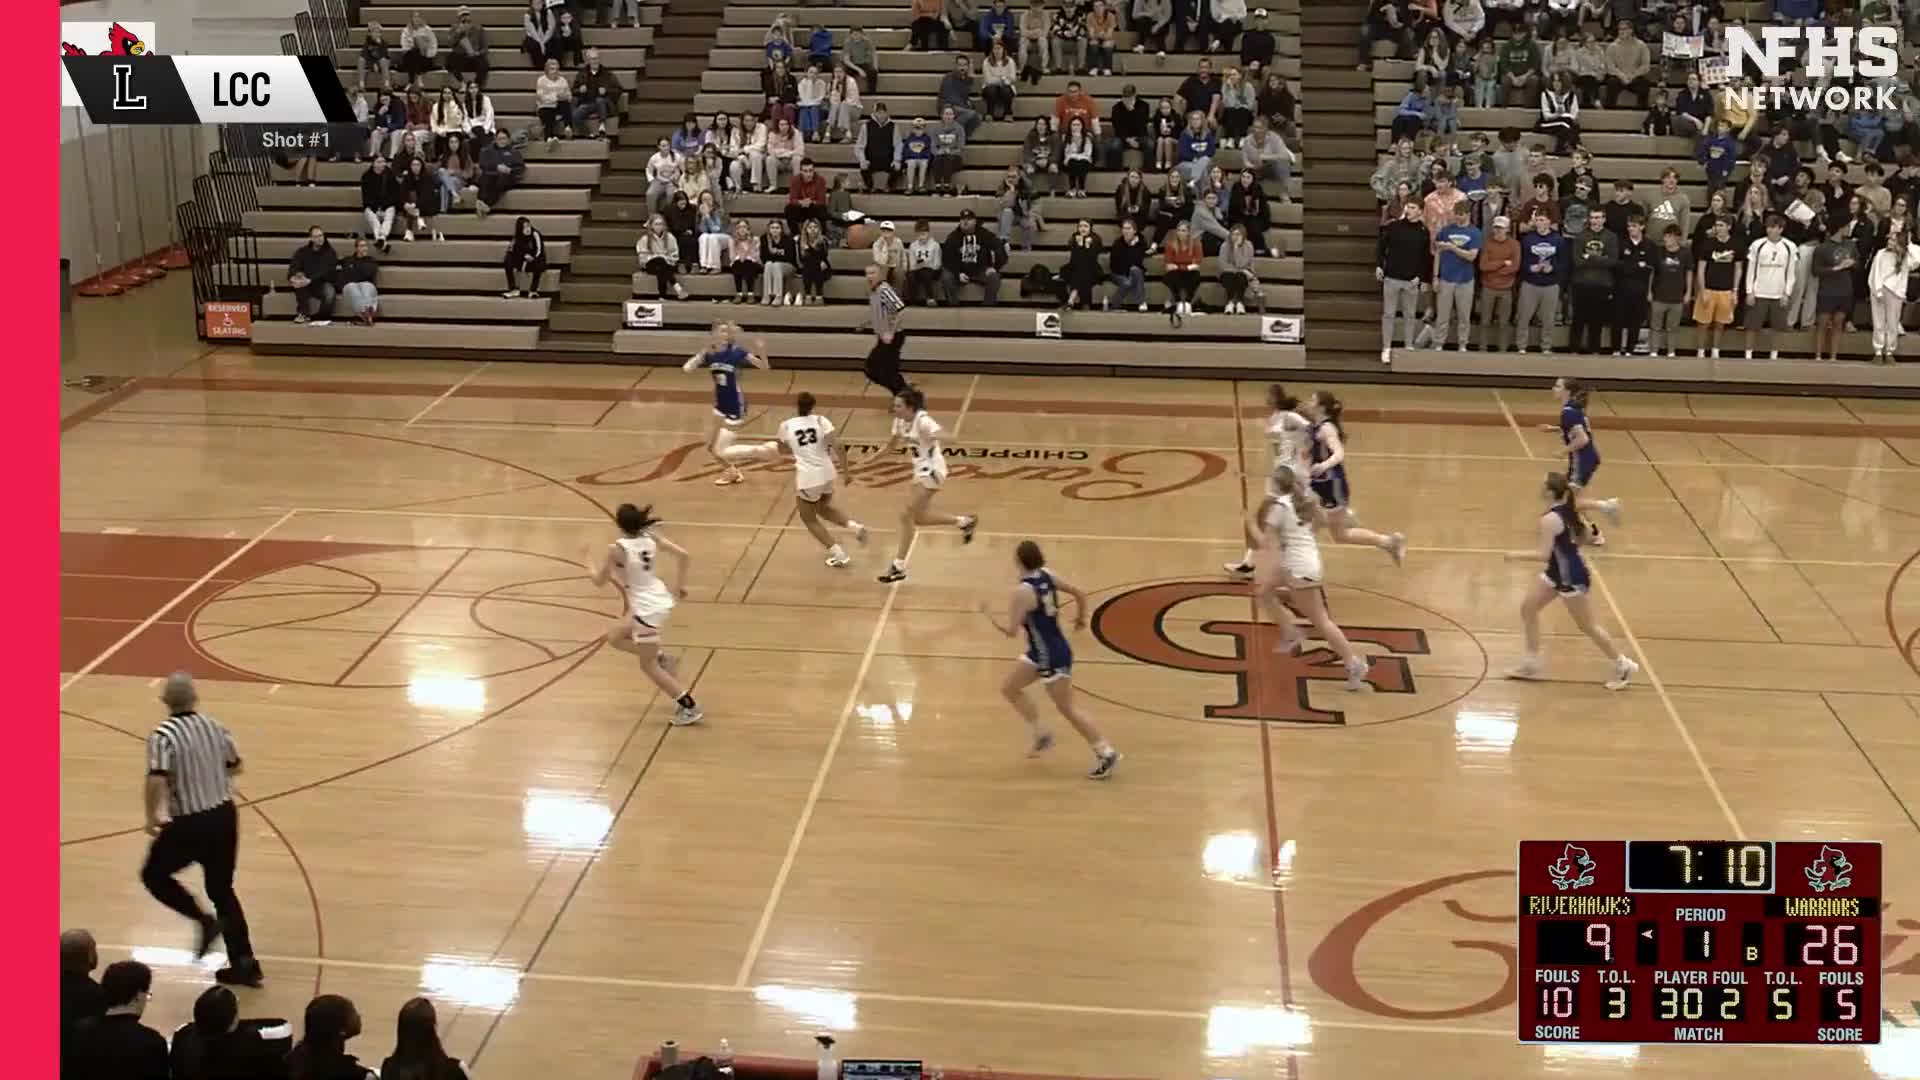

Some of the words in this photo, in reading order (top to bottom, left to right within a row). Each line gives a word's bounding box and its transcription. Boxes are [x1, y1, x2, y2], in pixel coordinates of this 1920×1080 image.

[208, 304, 248, 312] RESERVED
[212, 327, 248, 335] SEATING
[794, 428, 820, 447] 23
